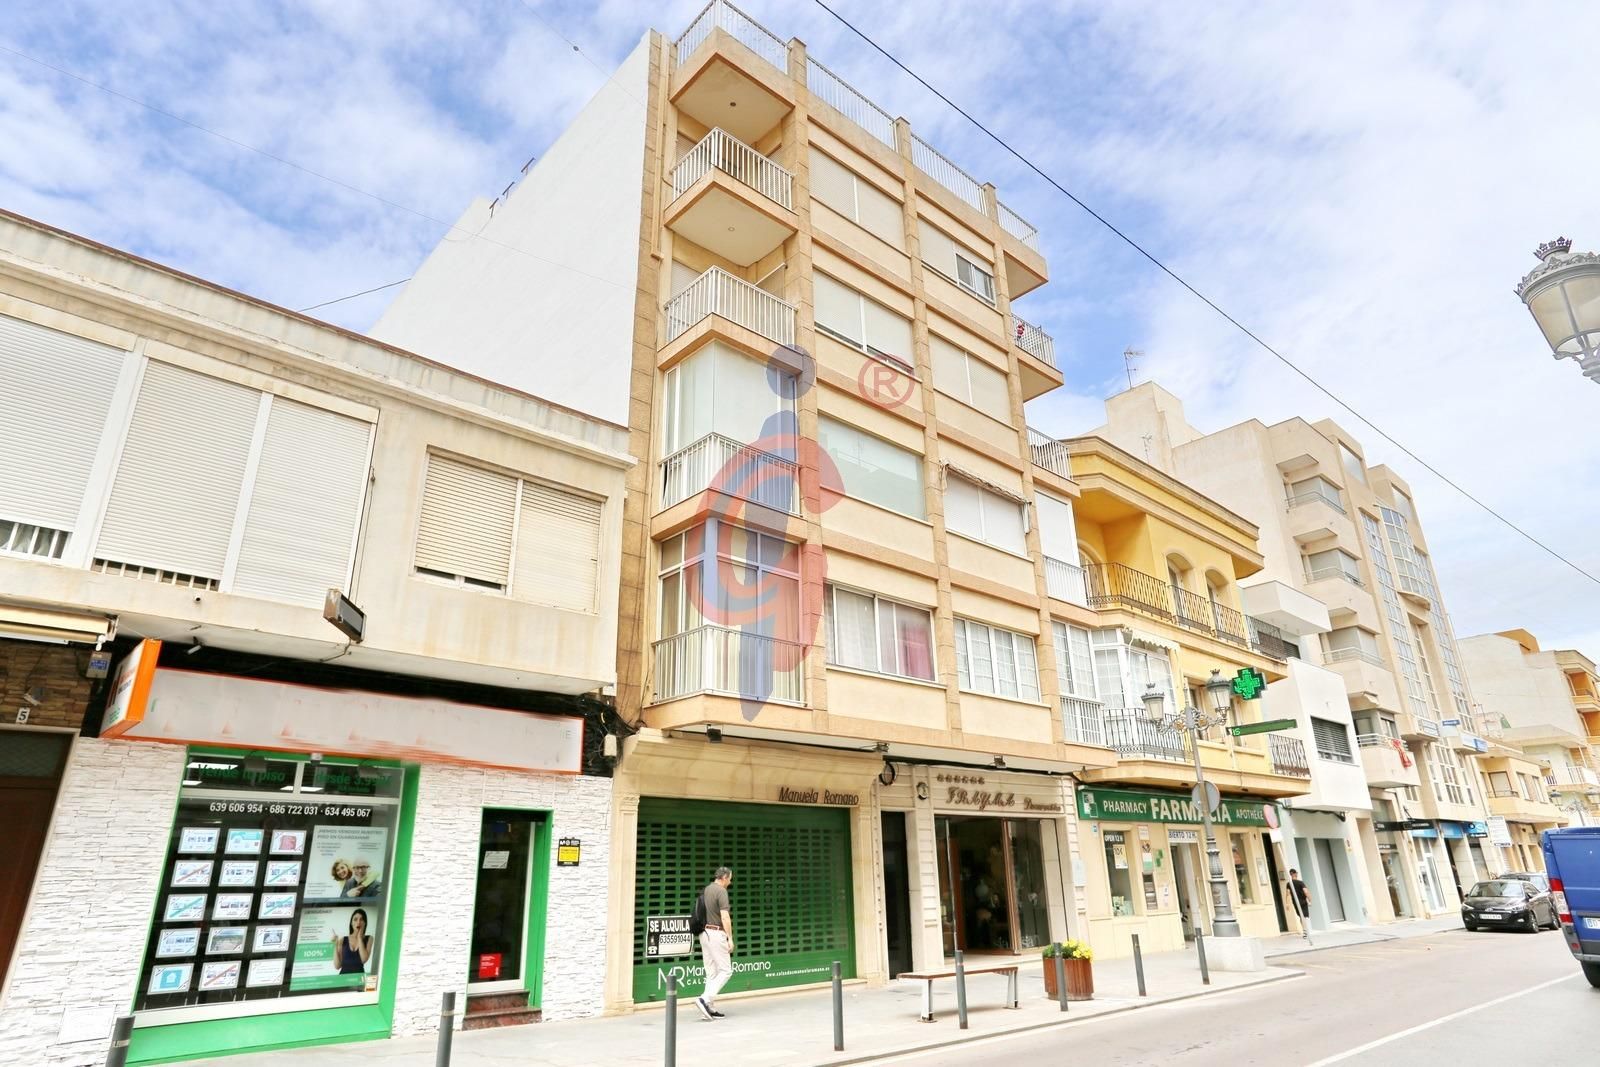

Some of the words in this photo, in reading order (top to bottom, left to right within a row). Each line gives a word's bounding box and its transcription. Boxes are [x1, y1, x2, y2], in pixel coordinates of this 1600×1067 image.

[19, 711, 27, 721] 5
[258, 771, 286, 783] piso
[779, 786, 819, 803] Manuela
[823, 789, 860, 805] Romano
[209, 802, 227, 812] 639
[228, 803, 245, 813] 606
[247, 803, 263, 813] 954
[269, 804, 285, 814] 686
[287, 805, 303, 815] 722
[303, 806, 318, 816] 031
[325, 807, 340, 816] 634
[341, 808, 356, 817] 495
[356, 808, 371, 817] 067
[1103, 800, 1147, 814] PHARMACY
[1150, 798, 1232, 823] FARMIA
[1236, 808, 1264, 820] APOTHEKE
[649, 920, 659, 932] SE
[661, 919, 690, 932] ALQUILA
[731, 961, 771, 973] Romano
